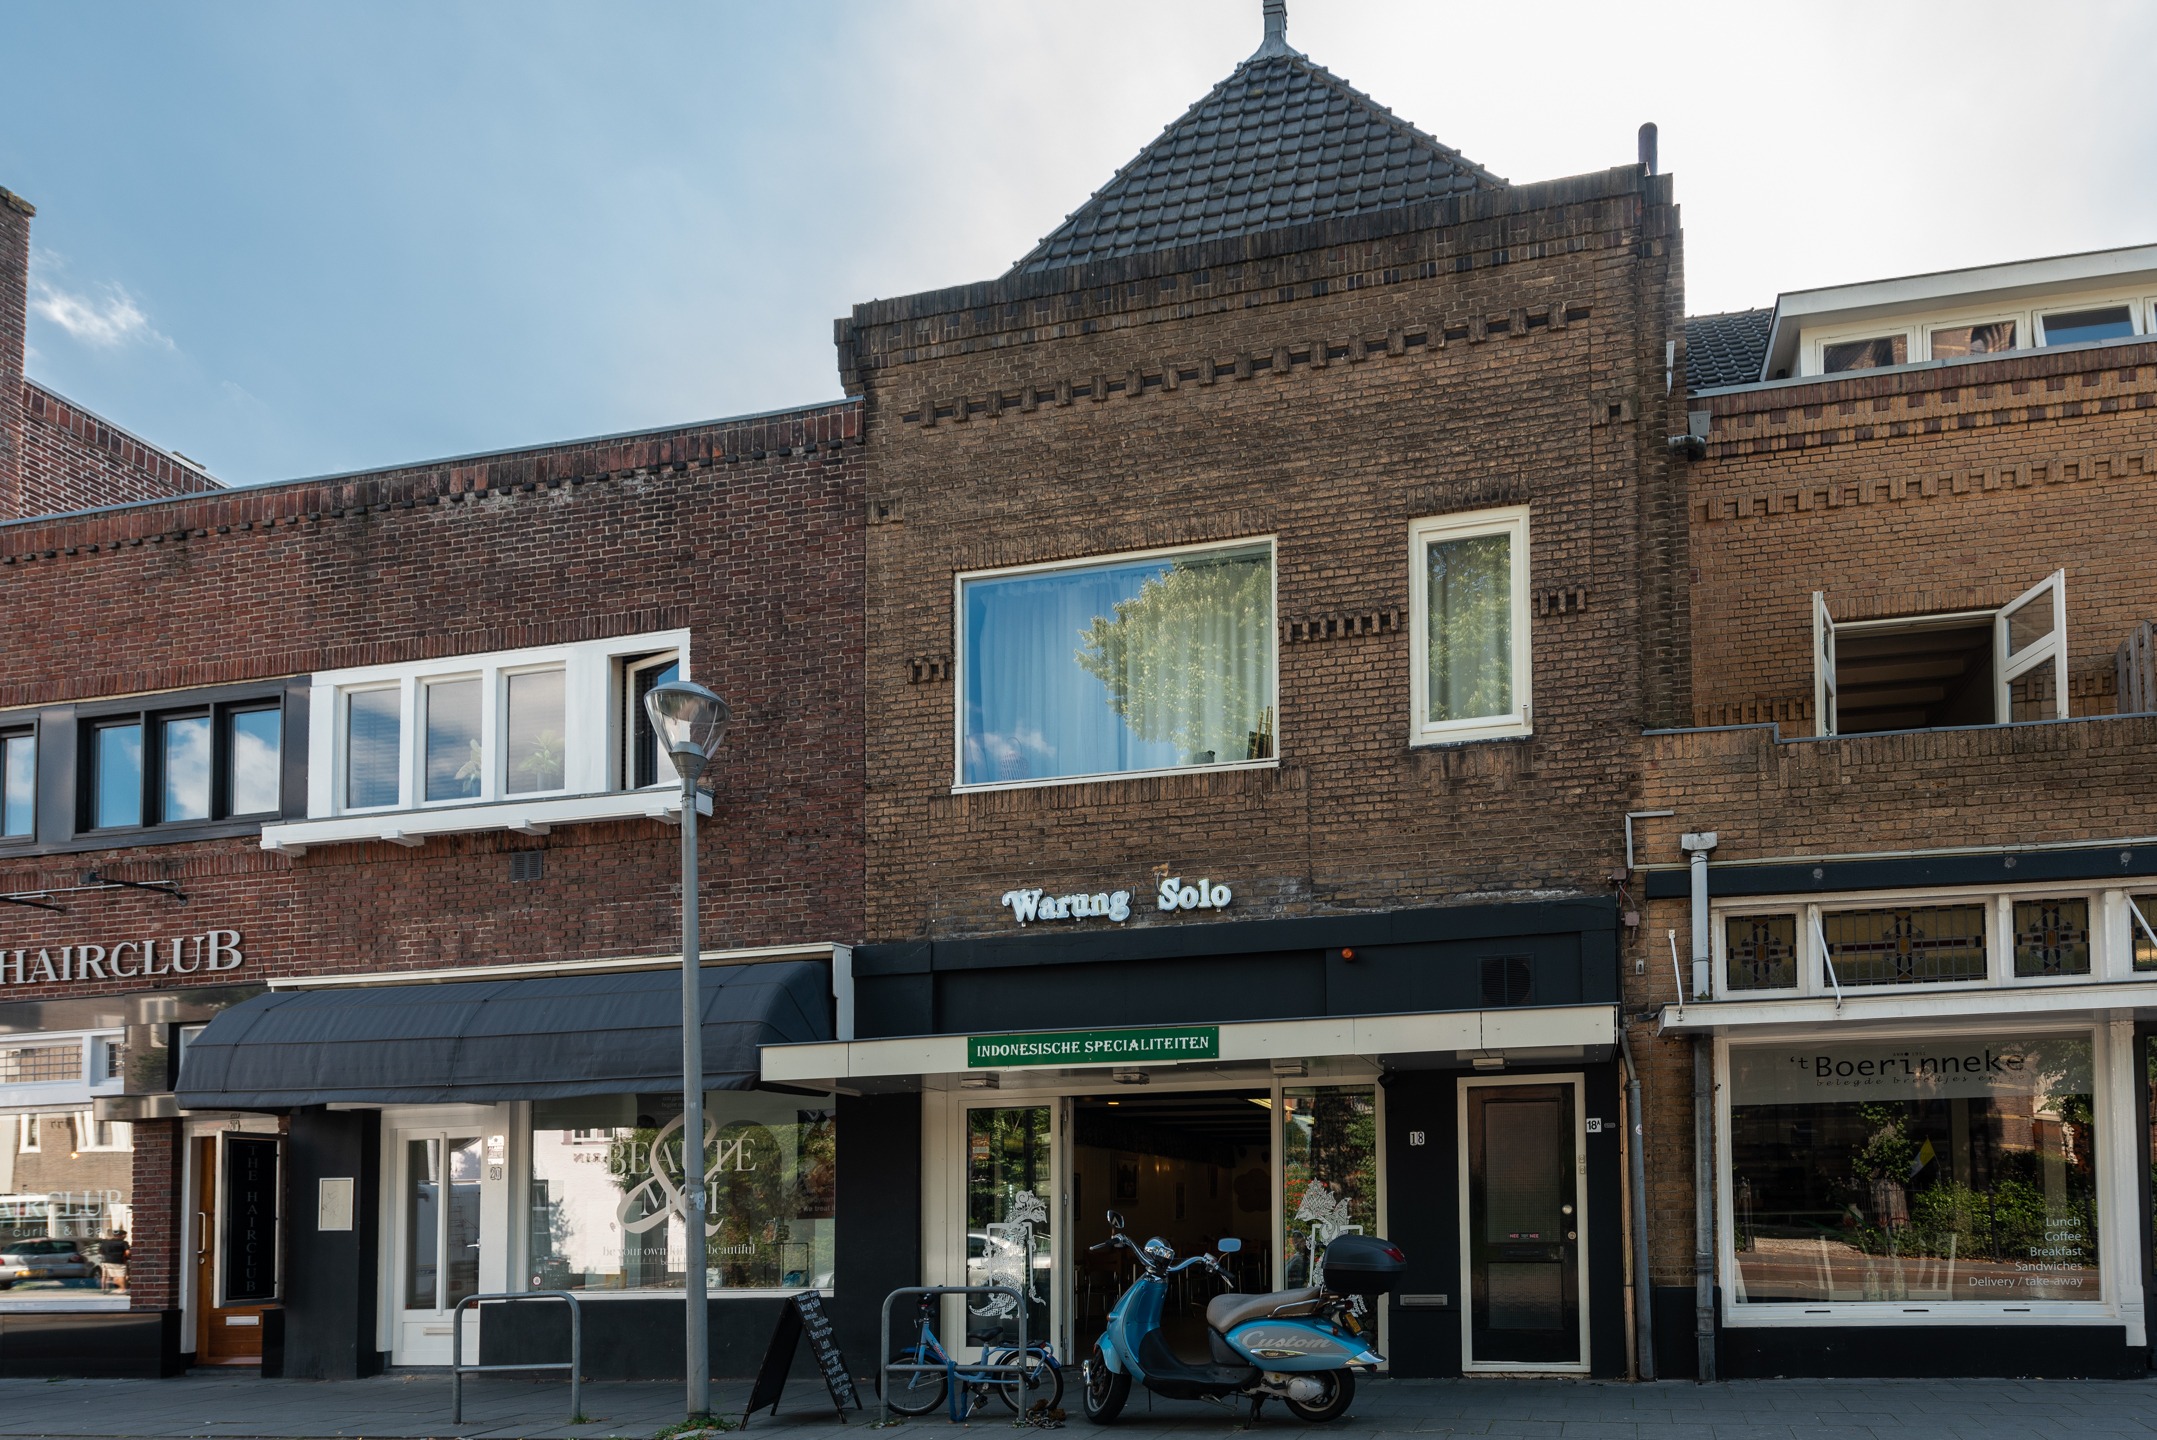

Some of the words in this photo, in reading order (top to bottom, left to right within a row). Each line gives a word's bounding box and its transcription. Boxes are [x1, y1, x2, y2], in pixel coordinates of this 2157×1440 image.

[1002, 887, 1131, 922] Warung
[1158, 877, 1232, 911] Solo
[0, 929, 243, 985] HAIRCLUB
[977, 1041, 1081, 1058] INDONESISCHE
[1084, 1036, 1210, 1053] SPECIALITEITEN
[1816, 1050, 2025, 1078] Boerinneke
[1816, 1077, 1884, 1087] belegde
[1410, 1131, 1425, 1146] 18
[248, 1145, 258, 1181] THE
[2046, 1217, 2080, 1227] Lunch
[64, 1225, 73, 1236] &
[2045, 1232, 2081, 1241] Coffee
[246, 1191, 258, 1292] HAIRCLUB
[709, 1243, 756, 1255] beautiful
[2030, 1246, 2083, 1256] Breakfast
[2015, 1261, 2083, 1271] Sandwiches
[1969, 1277, 2016, 1288] Delivery
[2025, 1276, 2083, 1288] take-away
[1241, 1330, 1332, 1349] Custom
